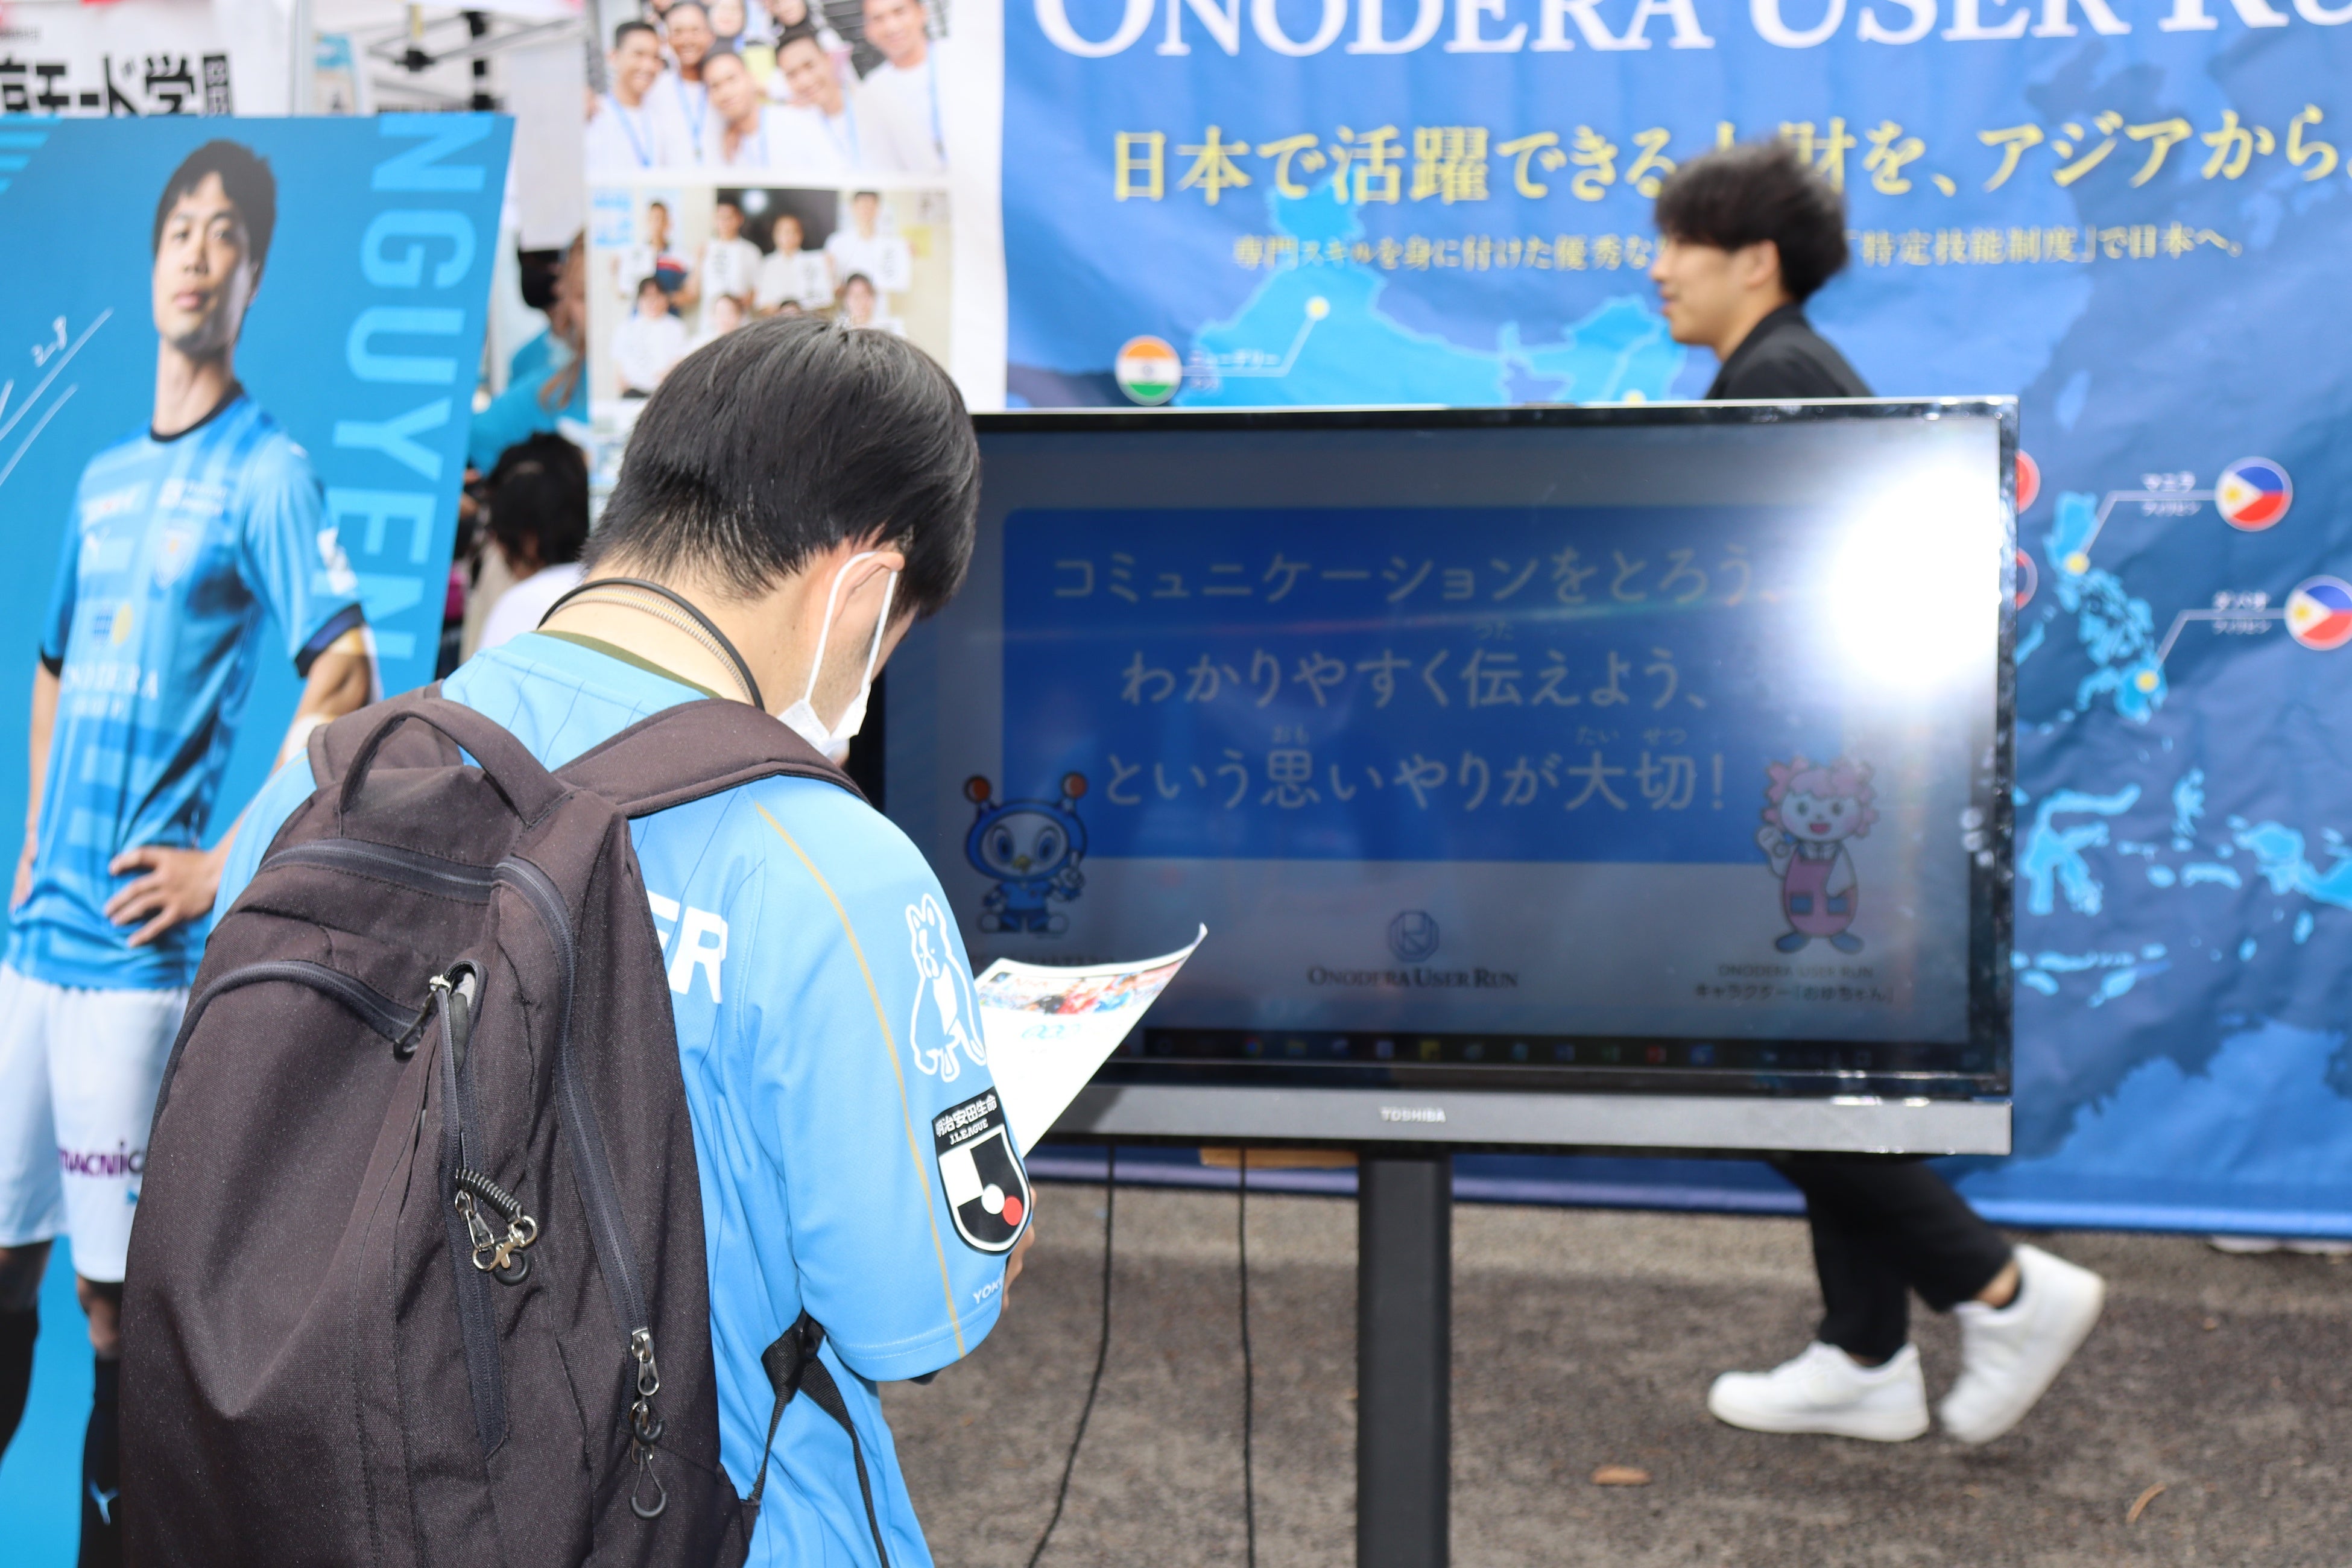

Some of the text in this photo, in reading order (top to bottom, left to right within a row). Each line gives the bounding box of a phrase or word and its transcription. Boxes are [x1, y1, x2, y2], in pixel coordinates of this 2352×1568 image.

[1233, 233, 1668, 273] 専門スキルを身に付けた優秀な
[1121, 646, 1708, 710] わかりやすく伝えよう、
[1105, 750, 1725, 811] という思いやりが大切!
[1307, 966, 1519, 988] ONODERA USER RUN
[935, 1093, 997, 1137] 明治安田生命
[949, 1118, 989, 1146] J.LEAGUE
[1380, 1107, 1447, 1124] TOSHIBA
